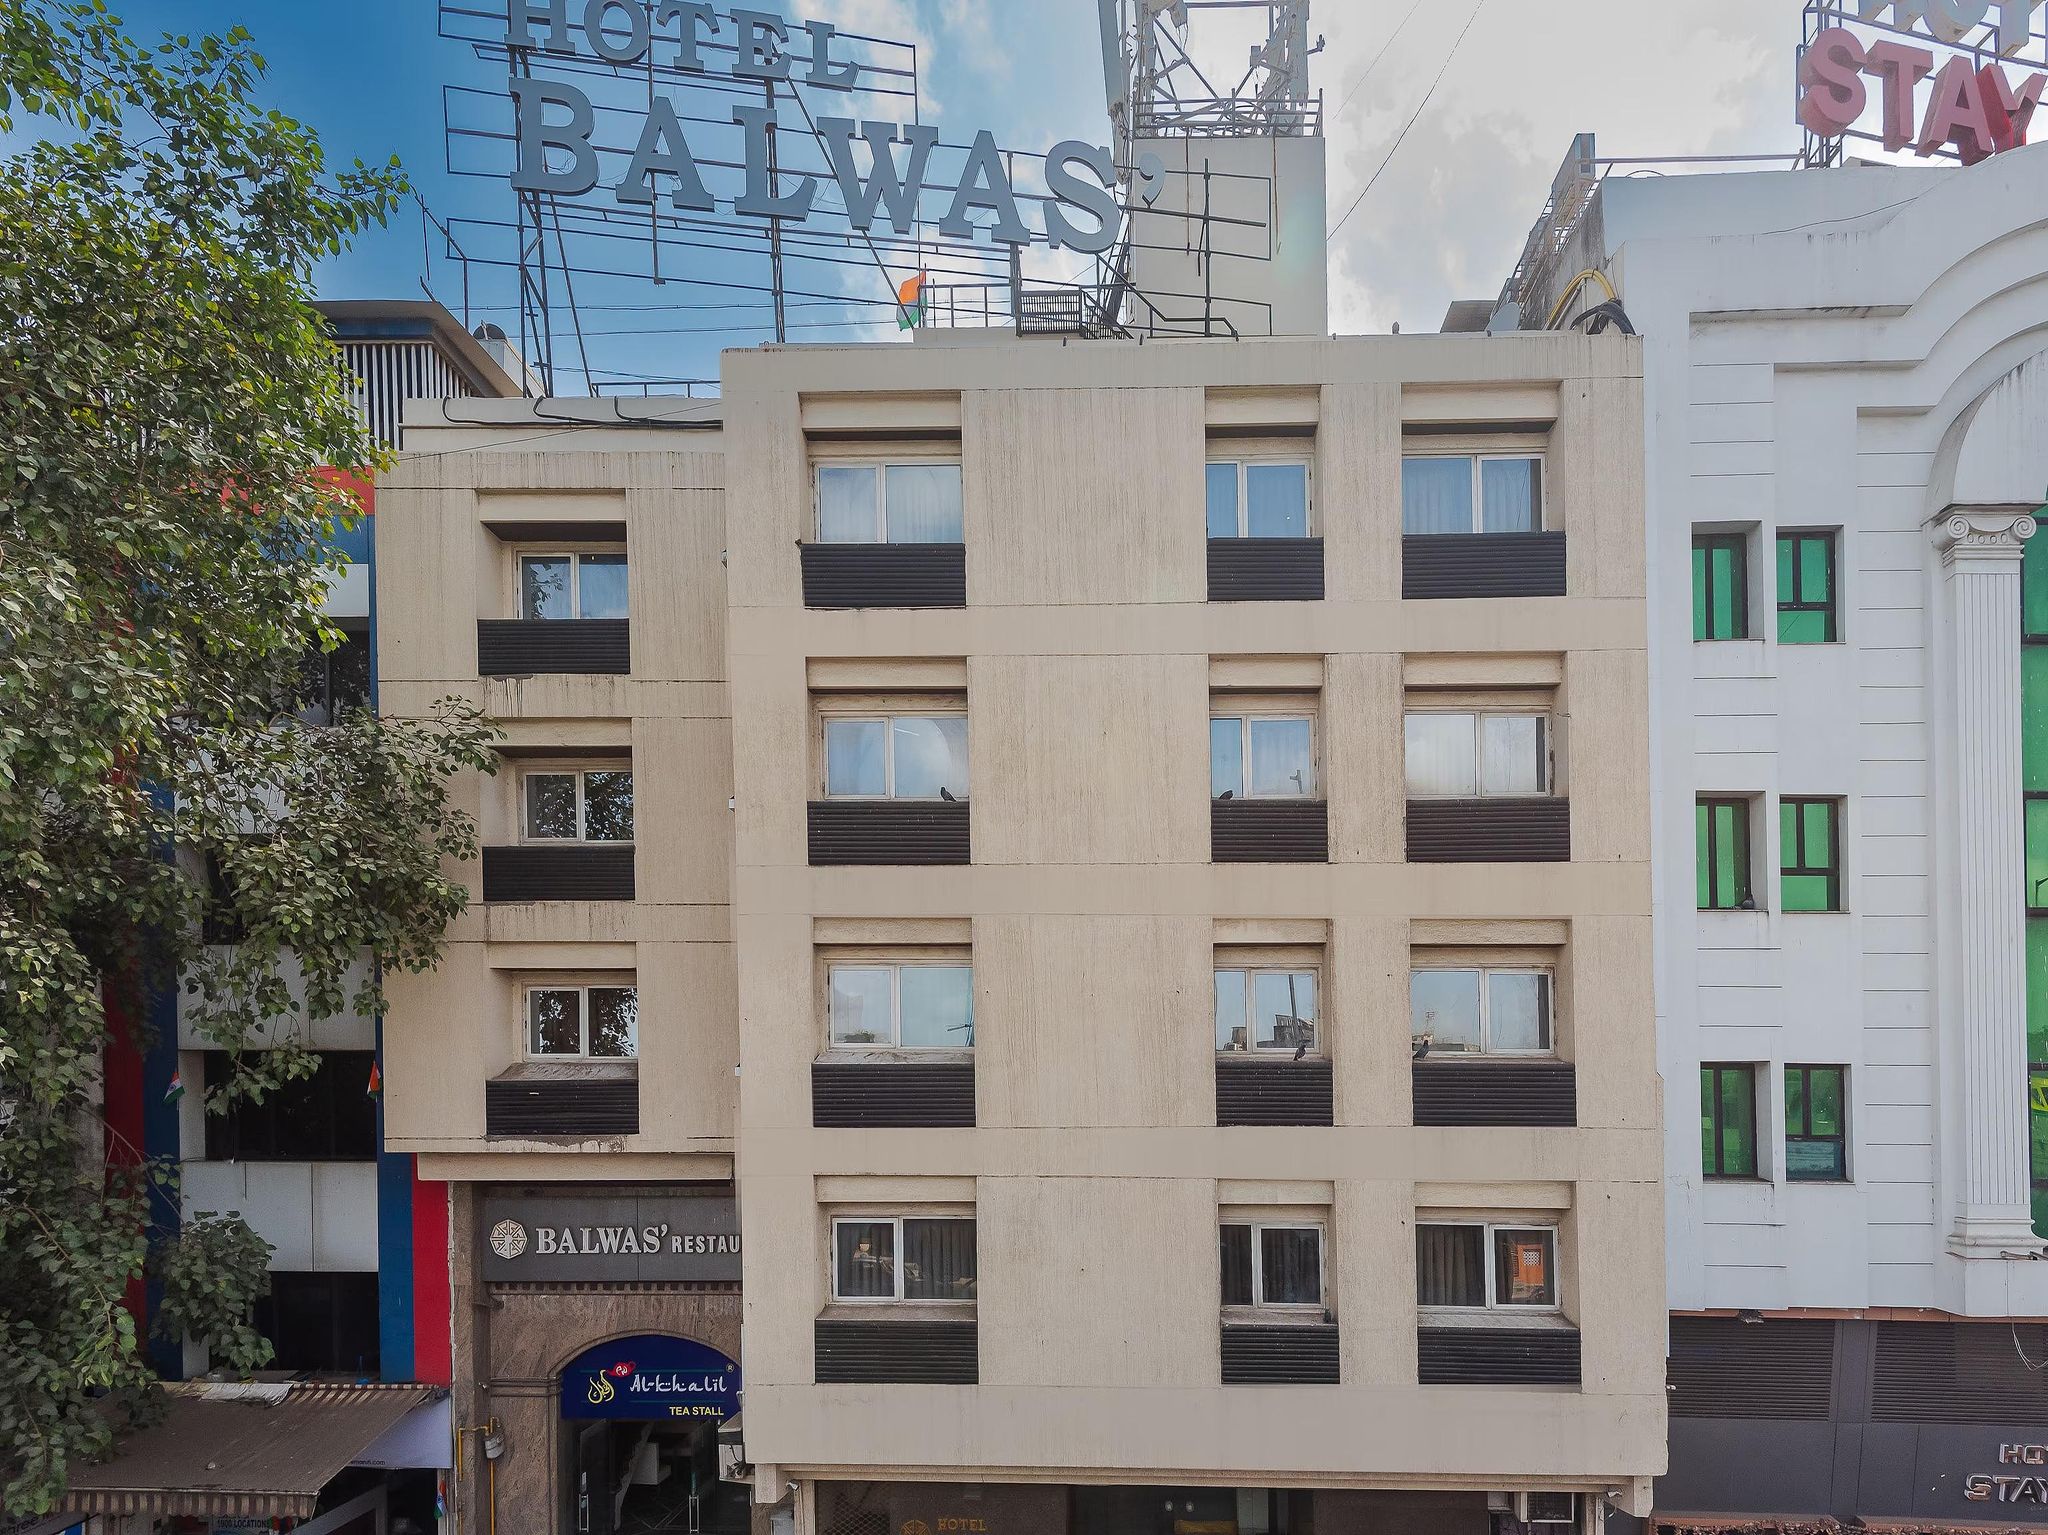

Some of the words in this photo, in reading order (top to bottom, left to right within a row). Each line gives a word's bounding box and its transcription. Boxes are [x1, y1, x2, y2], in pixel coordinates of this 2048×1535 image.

[504, 0, 860, 93] HOTEL
[1798, 26, 2048, 167] STAY
[508, 76, 1168, 254] BALWAS'
[535, 1223, 669, 1255] BALWAS'
[671, 1235, 740, 1254] RESTAU
[669, 1406, 690, 1416] TEA
[692, 1406, 724, 1416] STALL
[1998, 1443, 2048, 1465] HO
[937, 1518, 986, 1531] HOTEL
